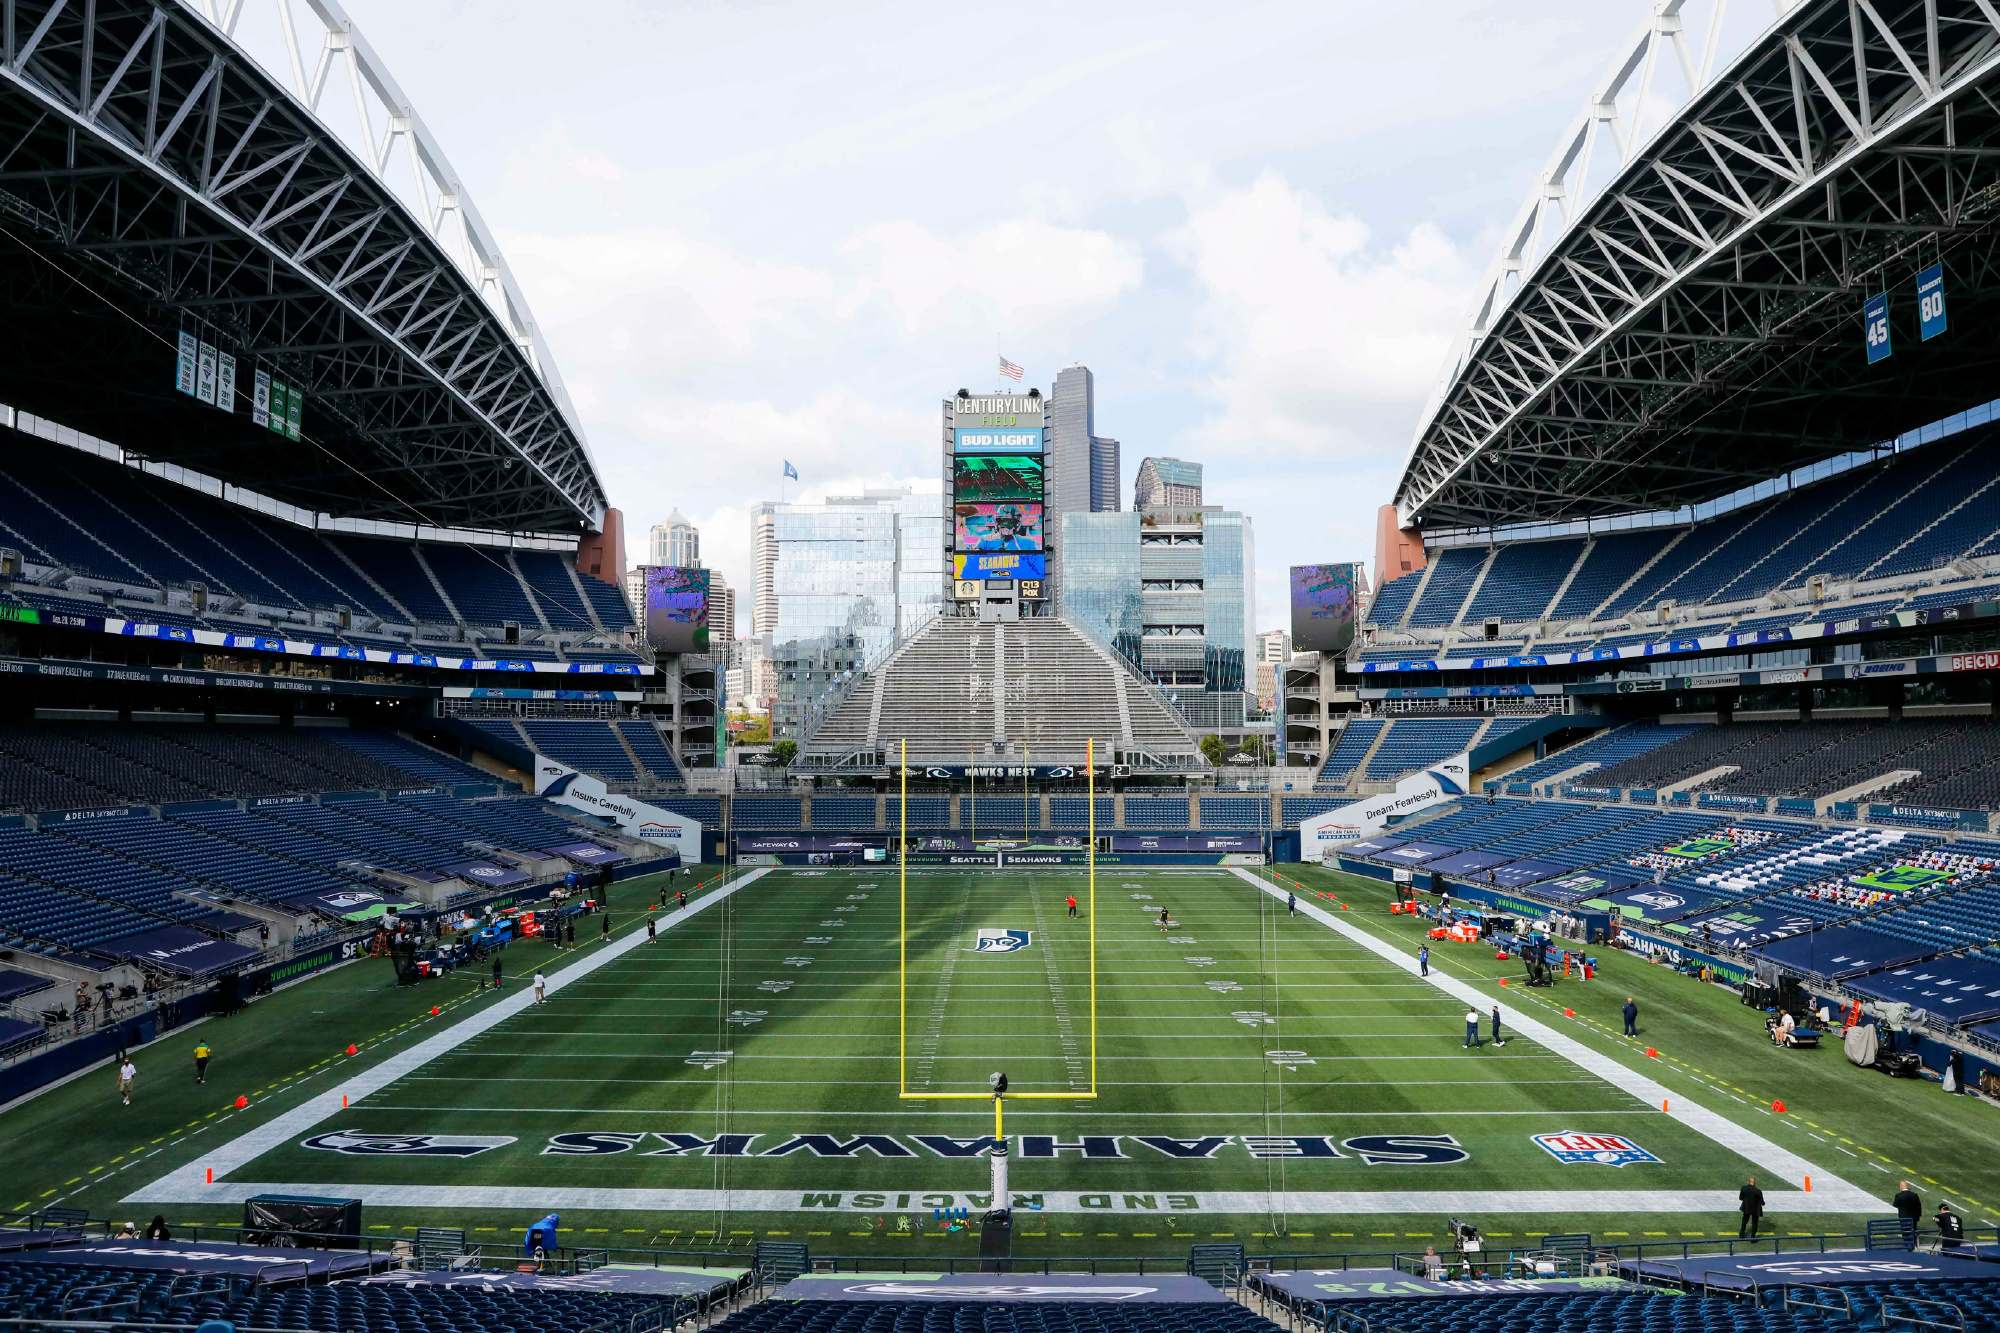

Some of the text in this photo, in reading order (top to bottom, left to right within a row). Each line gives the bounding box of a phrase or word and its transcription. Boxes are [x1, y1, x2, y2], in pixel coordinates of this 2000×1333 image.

[1920, 291, 1943, 323] 80
[1867, 317, 1888, 347] 45
[200, 347, 216, 361] CHAMPS
[956, 397, 1041, 415] CENTURYLINK
[982, 415, 1017, 426] FIELD
[961, 434, 1036, 446] BUD LIGHT
[978, 554, 1020, 570] SEAHAWKS
[1021, 580, 1040, 589] Q13
[1022, 588, 1039, 597] FOX
[134, 622, 159, 637] SEAHAWKS
[1833, 617, 1860, 635] SEAHAWKS
[1736, 631, 1758, 647] SEAHAWKS
[471, 660, 497, 670] SEAHAWKS
[578, 663, 604, 673] SEAHAWKS
[1374, 661, 1400, 672] SEAHAWKS
[1482, 657, 1509, 669] SEAHAWKS
[1864, 662, 1906, 674] BOEING
[1952, 654, 1999, 670] BECU
[39, 664, 49, 674] 45
[48, 665, 65, 676] KENNY
[65, 666, 83, 677] EASLEY
[106, 669, 114, 679] 17
[215, 677, 224, 686] 96
[1769, 672, 1805, 684] verizon
[532, 689, 557, 699] SEAHAWKS
[964, 767, 1037, 777] HAWKS NEST
[571, 788, 637, 820] Insure Carefully
[1713, 794, 1731, 802] DELTA
[1366, 789, 1438, 820] Dream Fearlessly
[72, 811, 95, 820] DELTA
[116, 808, 129, 816] CLUB
[1899, 807, 1922, 816] DELTA
[1946, 810, 1960, 819] CLUB
[540, 1131, 1470, 1165] SEAHAWKS
[1545, 1135, 1629, 1151] NFL
[800, 1193, 1202, 1210] END RACISM
[1313, 1281, 1448, 1294] 12s
